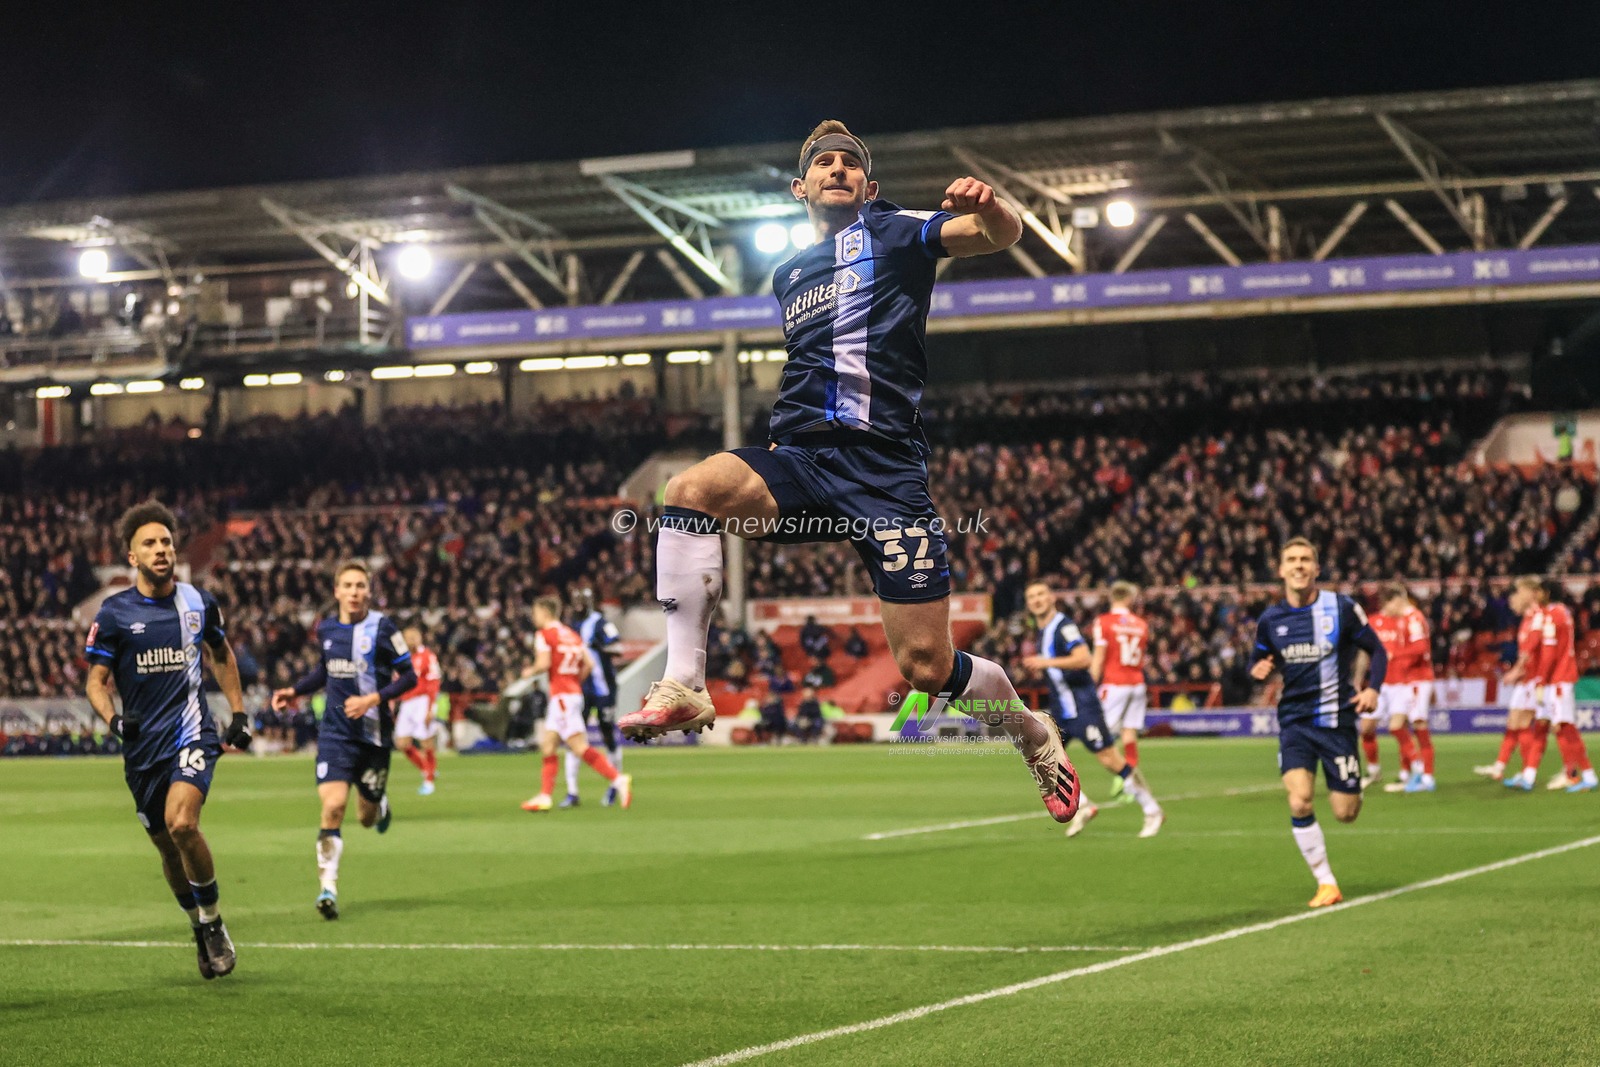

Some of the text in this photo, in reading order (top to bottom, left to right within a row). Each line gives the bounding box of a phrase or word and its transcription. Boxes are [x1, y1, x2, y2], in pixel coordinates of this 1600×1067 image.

[786, 283, 837, 320] utilita
[874, 526, 934, 572] 32
[136, 647, 184, 666] utilita
[179, 748, 206, 771] 16
[1334, 754, 1360, 781] 14
